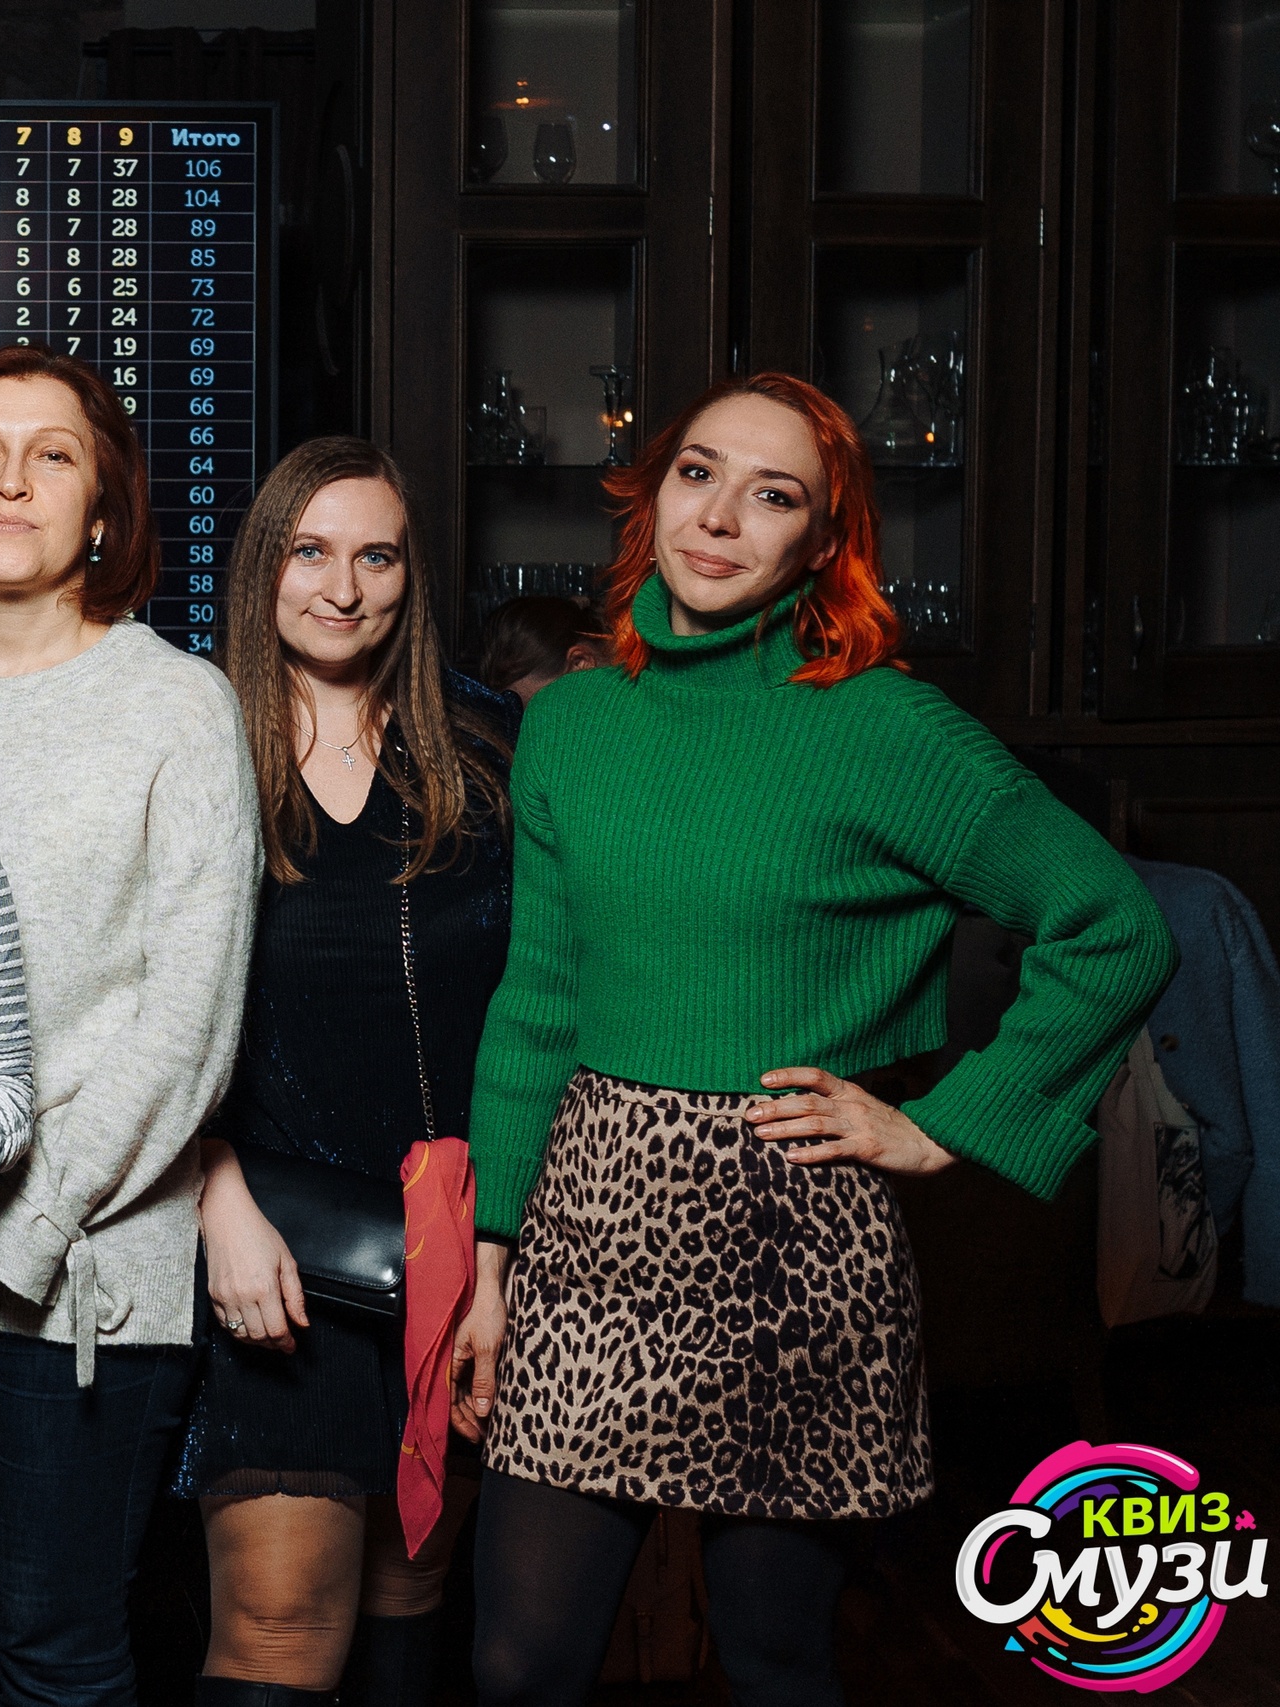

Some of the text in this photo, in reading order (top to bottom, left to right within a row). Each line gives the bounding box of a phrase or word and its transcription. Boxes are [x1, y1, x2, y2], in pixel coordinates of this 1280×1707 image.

[17, 127, 31, 144] 7
[68, 127, 81, 145] 8
[120, 128, 133, 145] 9
[172, 129, 240, 146] Итого
[17, 158, 30, 175] 7
[68, 159, 81, 176] 7
[114, 159, 138, 176] 37
[186, 160, 221, 177] 106
[16, 188, 29, 206] 8
[68, 189, 80, 206] 8
[113, 189, 137, 206] 28
[186, 190, 220, 206] 104
[17, 218, 30, 236] 6
[68, 218, 80, 236] 7
[112, 219, 137, 236] 28
[191, 219, 215, 236] 89
[17, 248, 29, 266] 5
[67, 248, 80, 266] 8
[112, 249, 137, 266] 28
[191, 249, 215, 266] 85
[17, 278, 30, 295] 6
[68, 278, 81, 295] 6
[113, 278, 137, 296] 25
[192, 279, 214, 296] 73
[17, 307, 30, 325] 2
[68, 308, 80, 325] 7
[112, 308, 137, 325] 24
[191, 309, 214, 326] 72
[68, 337, 80, 355] 7
[114, 338, 136, 355] 19
[191, 338, 214, 355] 69
[114, 367, 136, 385] 16
[190, 368, 214, 385] 69
[190, 398, 214, 415] 66
[190, 427, 213, 444] 66
[190, 457, 213, 474] 64
[190, 486, 214, 504] 60
[190, 516, 214, 533] 60
[190, 546, 213, 563] 58
[190, 575, 213, 592] 58
[190, 604, 214, 622] 50
[188, 634, 213, 652] 34
